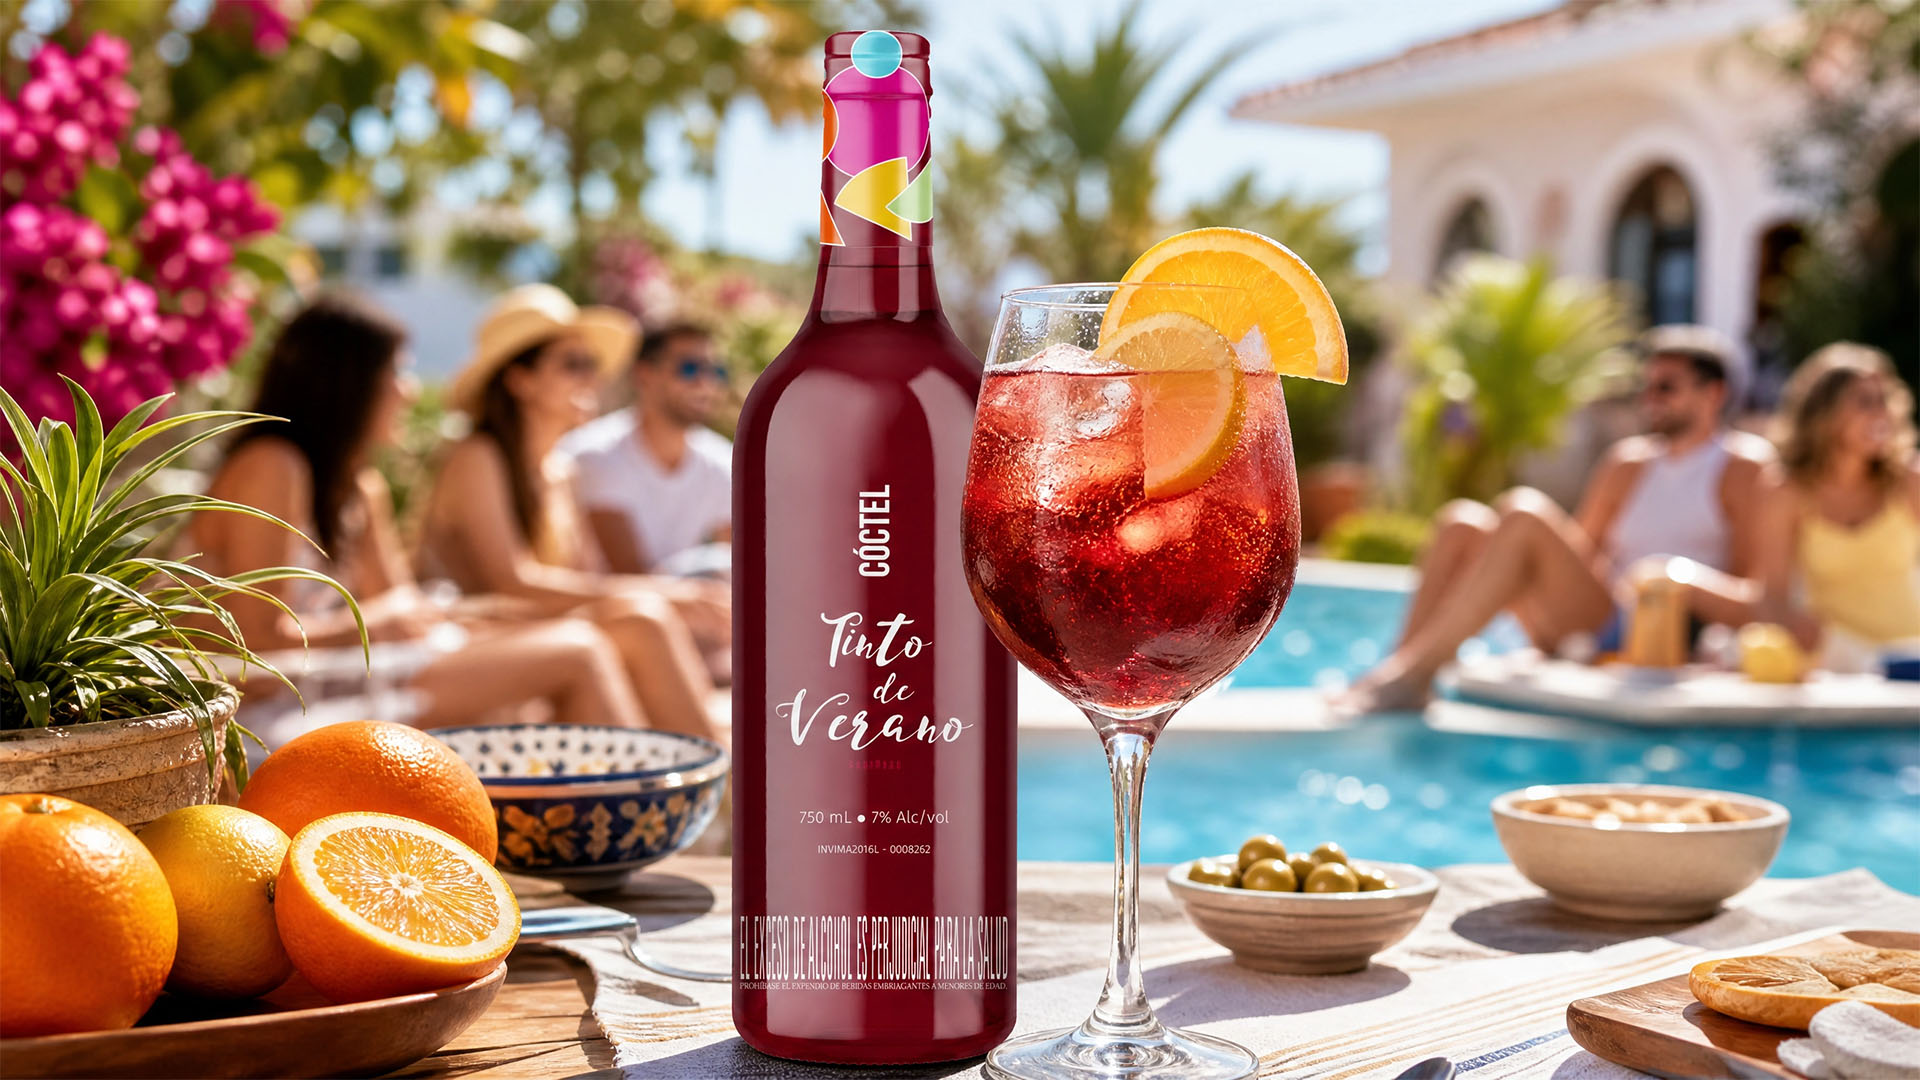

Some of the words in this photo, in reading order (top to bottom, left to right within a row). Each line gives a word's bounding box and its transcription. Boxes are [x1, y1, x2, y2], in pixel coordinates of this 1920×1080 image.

[852, 484, 890, 577] CÓCTEL
[820, 611, 932, 668] Tinto
[873, 672, 915, 704] de
[775, 688, 974, 751] Verano
[799, 811, 824, 824] 750
[829, 811, 852, 824] mL
[871, 811, 892, 824] 7%
[896, 809, 949, 825] Alc/vol
[817, 845, 879, 854] INVIMA2016L
[889, 845, 931, 854] 0008262
[740, 916, 750, 980] EL
[754, 915, 789, 980] EXCESO
[793, 916, 805, 980] DE
[807, 915, 852, 981] ALCOHOL
[857, 915, 868, 981] ES
[871, 915, 930, 980] PERJUDICIAL
[934, 916, 960, 980] PARA
[963, 916, 975, 980] LA
[977, 915, 1008, 980] SALUD
[740, 982, 780, 990] PROHÍBASE
[781, 982, 791, 990] EL
[791, 982, 829, 990] EXPENDIO
[830, 982, 840, 990] DE
[841, 982, 872, 990] BEBIDAS
[873, 982, 930, 990] EMBRIAGANTES
[931, 982, 937, 990] A
[937, 982, 973, 990] MENORES
[974, 982, 984, 990] DE
[985, 982, 1008, 990] EDAD.
